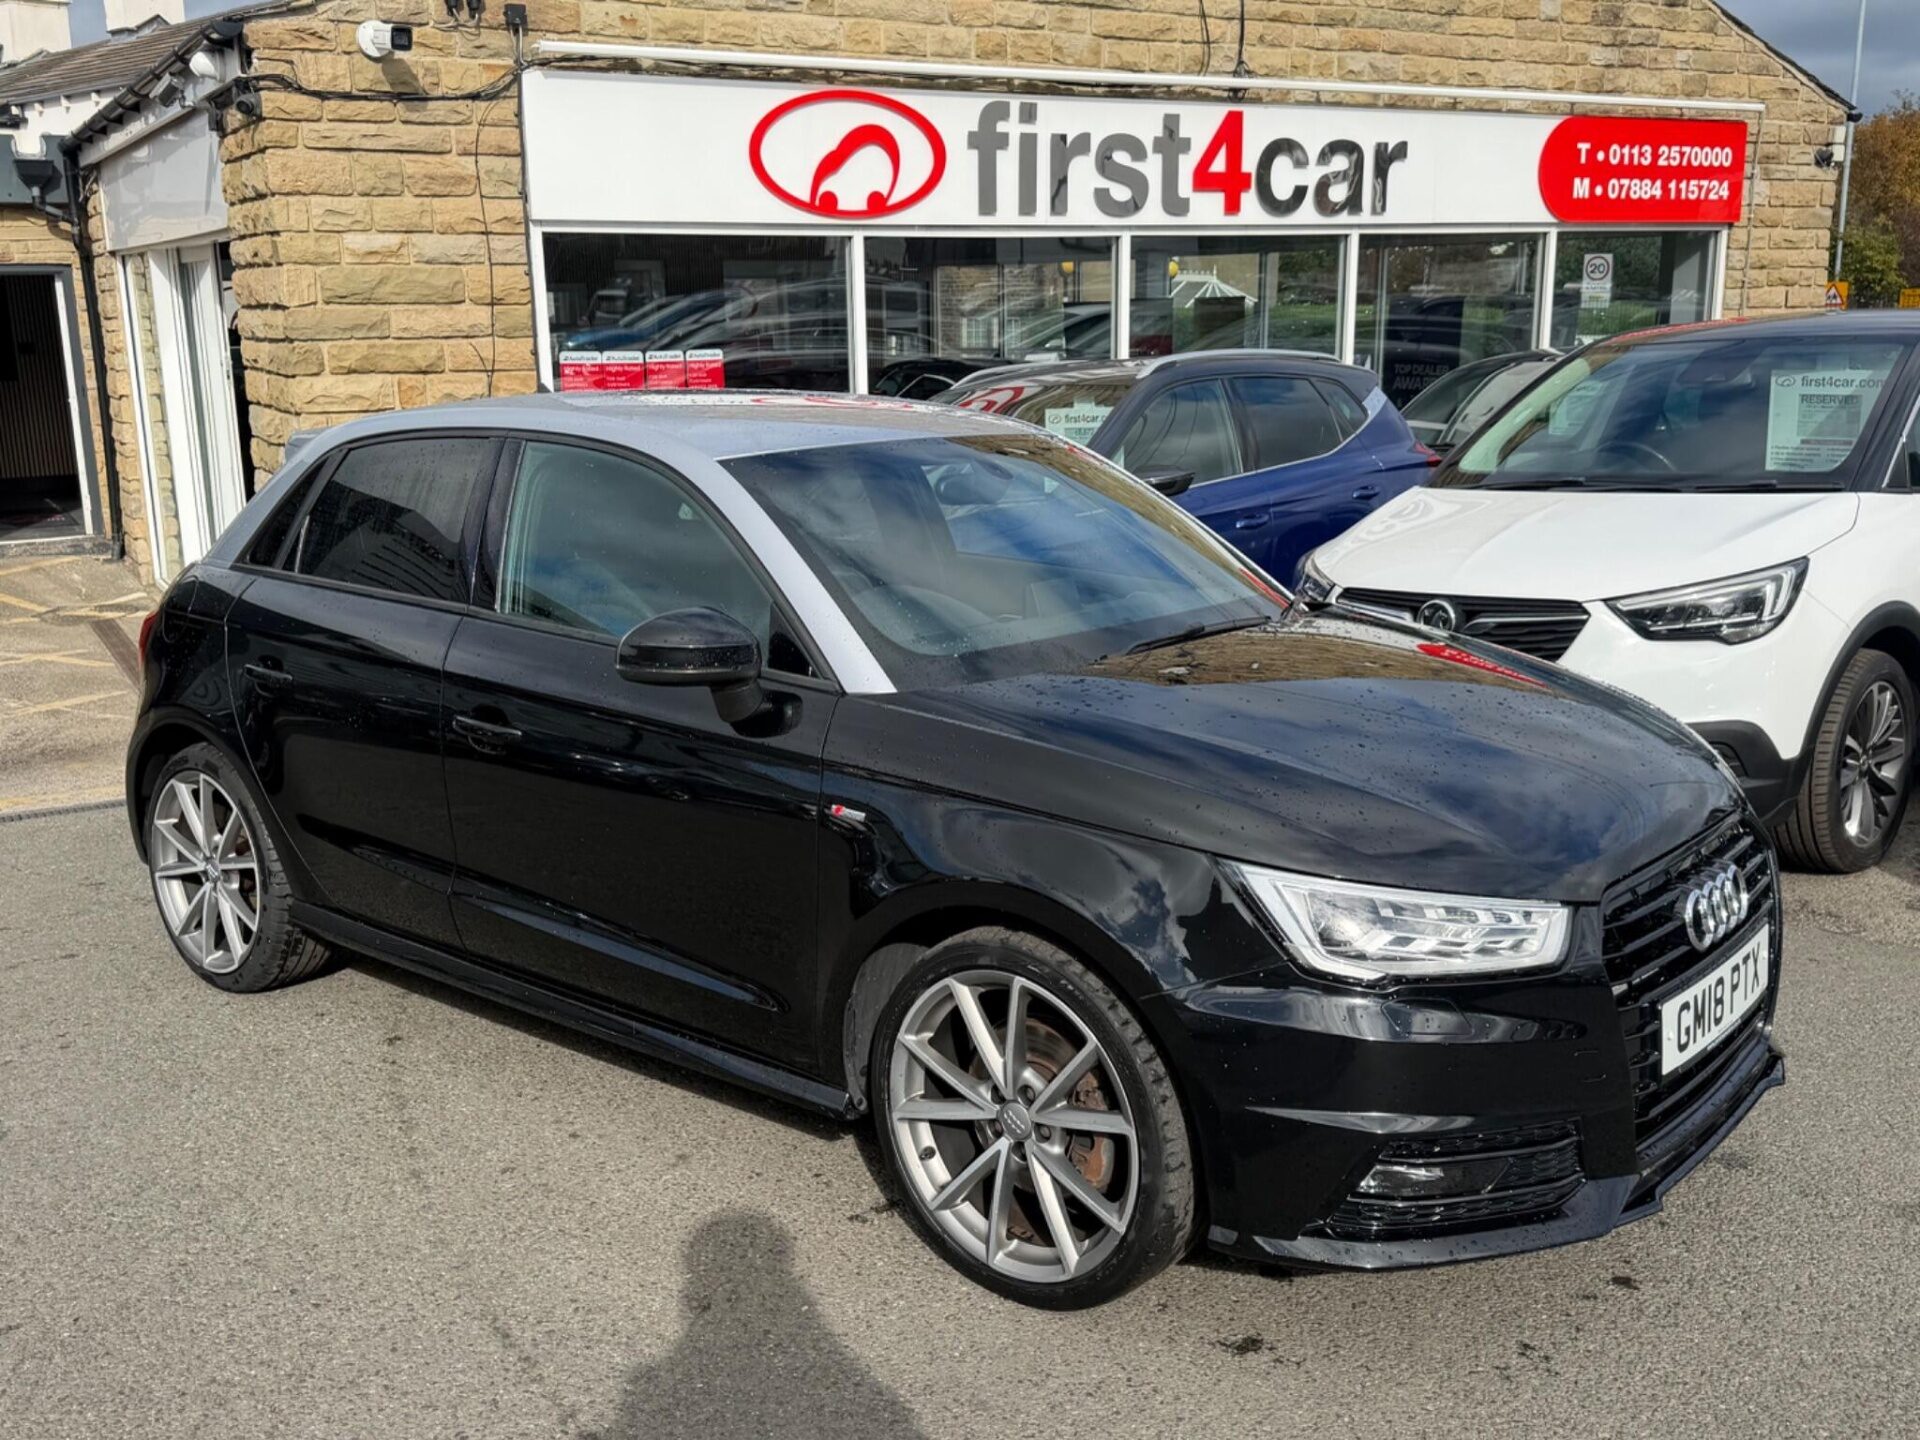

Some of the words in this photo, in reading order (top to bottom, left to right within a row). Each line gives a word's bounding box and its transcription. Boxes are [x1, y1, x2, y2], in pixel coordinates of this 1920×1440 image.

[967, 100, 1408, 218] first4car
[1577, 142, 1591, 164] T
[1609, 144, 1652, 166] 0113
[1657, 145, 1733, 167] 2570000
[1572, 177, 1591, 199] M
[1607, 178, 1663, 200] 07884
[1668, 179, 1730, 200] 115724
[1589, 263, 1606, 274] 20
[1394, 363, 1411, 375] TOP
[1800, 394, 1860, 405] RESERVED
[1677, 976, 1725, 1054] GM18
[1730, 941, 1761, 1015] PTX
